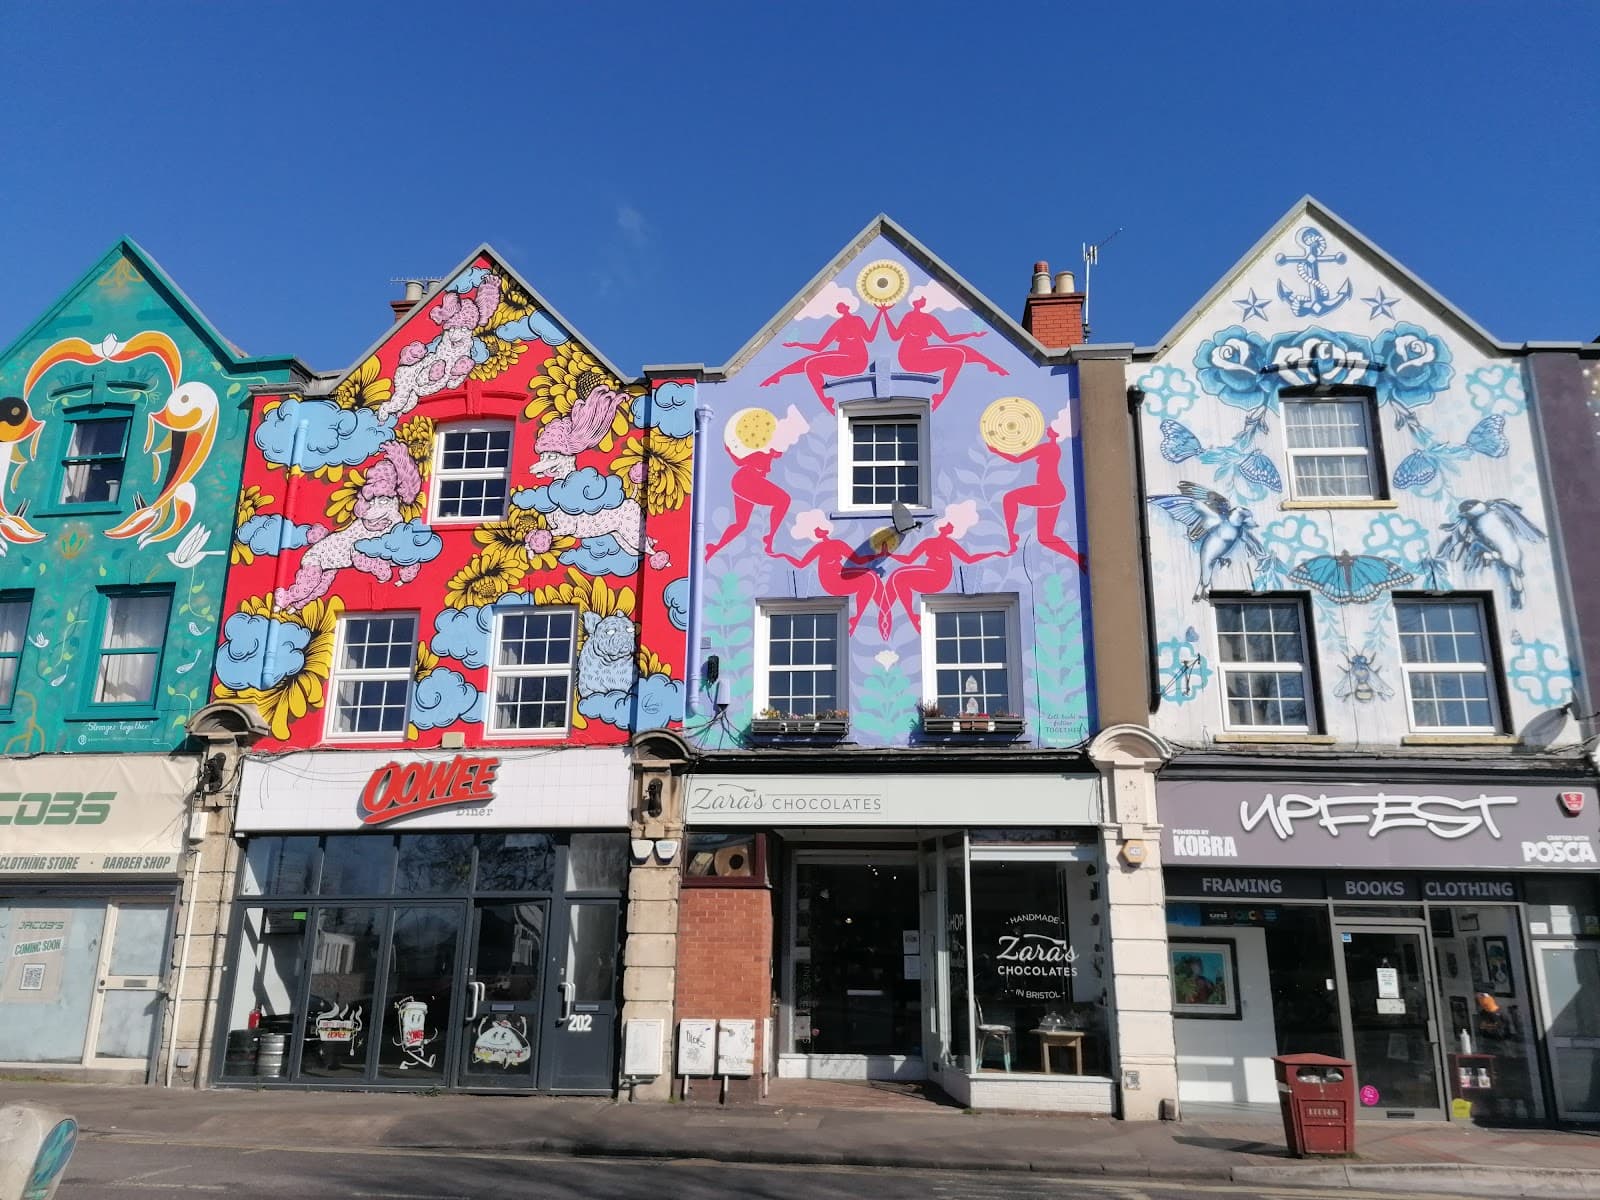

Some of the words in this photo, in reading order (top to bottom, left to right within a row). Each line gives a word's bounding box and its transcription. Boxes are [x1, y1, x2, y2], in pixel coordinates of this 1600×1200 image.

[363, 754, 499, 815] OOWEE
[692, 784, 764, 810] Zara's
[772, 798, 881, 810] CHOCOLATES
[456, 807, 493, 816] Diner
[1173, 836, 1238, 857] KOBRA
[1521, 841, 1597, 863] POSCA
[0, 856, 47, 869] CLOTHING
[48, 856, 80, 870] STORE
[102, 856, 143, 870] BARBER
[143, 856, 171, 870] SHOP
[1202, 878, 1282, 894] FRAMING
[1345, 880, 1405, 896] BOOKS
[1425, 881, 1514, 897] CLOTHING
[1010, 914, 1060, 924] HANDMADE
[14, 941, 41, 955] COMING
[42, 939, 62, 951] SOON
[996, 934, 1080, 962] Zara's
[997, 965, 1078, 977] CHOCOLATES
[1015, 988, 1025, 997] IN
[1026, 990, 1062, 999] BRISTOL
[567, 1014, 593, 1031] 202
